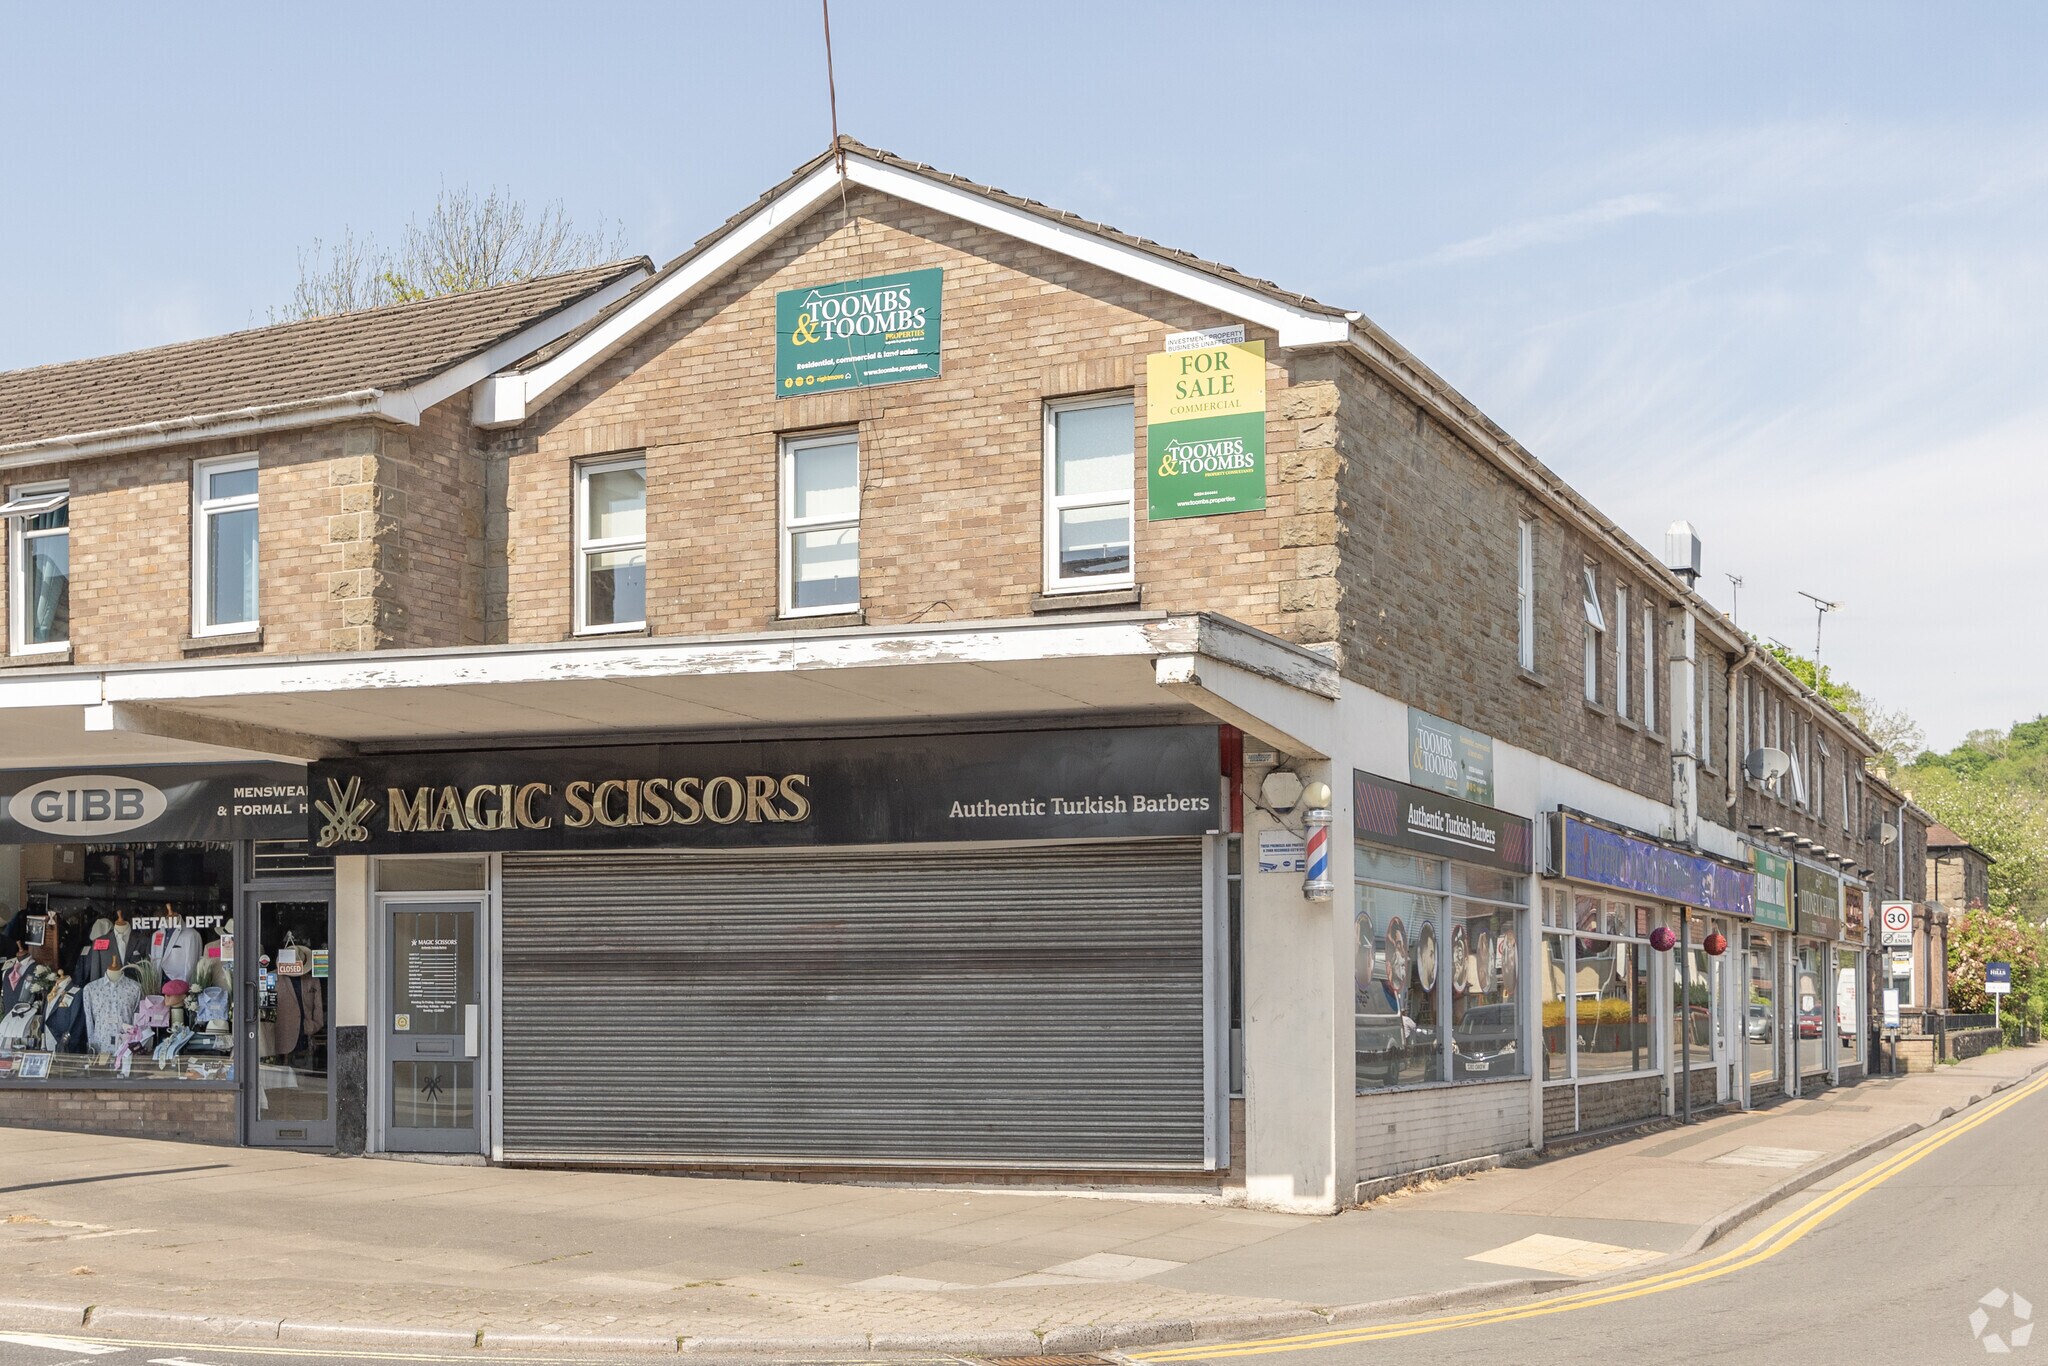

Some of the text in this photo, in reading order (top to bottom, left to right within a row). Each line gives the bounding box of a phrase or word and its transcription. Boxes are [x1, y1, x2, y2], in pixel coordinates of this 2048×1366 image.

[807, 288, 911, 322] TOOMBS
[792, 307, 926, 346] & TOOMBS
[885, 329, 925, 340] PROPERTIES
[1168, 330, 1243, 345] INVESTMENT PROPERTY
[1168, 337, 1243, 352] BUSINESS UNAFFECTED
[797, 358, 836, 370] Residential,
[836, 352, 877, 364] commercial
[883, 350, 899, 358] land
[899, 348, 918, 356] sales
[1181, 351, 1230, 375] FOR
[1176, 374, 1235, 400] SALE
[1170, 399, 1241, 415] COMMERCIAL
[1169, 440, 1243, 461] TOOMBS
[1158, 453, 1254, 477] & TOOMBS
[1417, 728, 1453, 759] TOOMBS
[1413, 737, 1424, 770] &
[1423, 751, 1458, 780] TOOMBS
[233, 785, 308, 798] MENSWEA
[387, 774, 812, 832] MAGIC SCISSORS
[30, 788, 145, 823] GIBB
[217, 805, 227, 816] &
[234, 804, 292, 816] FORMAL
[949, 793, 1210, 818] Authentic Turkish Barbers
[1408, 803, 1496, 845] Authentic Turkish Barbers
[132, 915, 223, 930] RETAIL DEPT
[1888, 913, 1905, 923] 30
[280, 965, 301, 973] CLOSED
